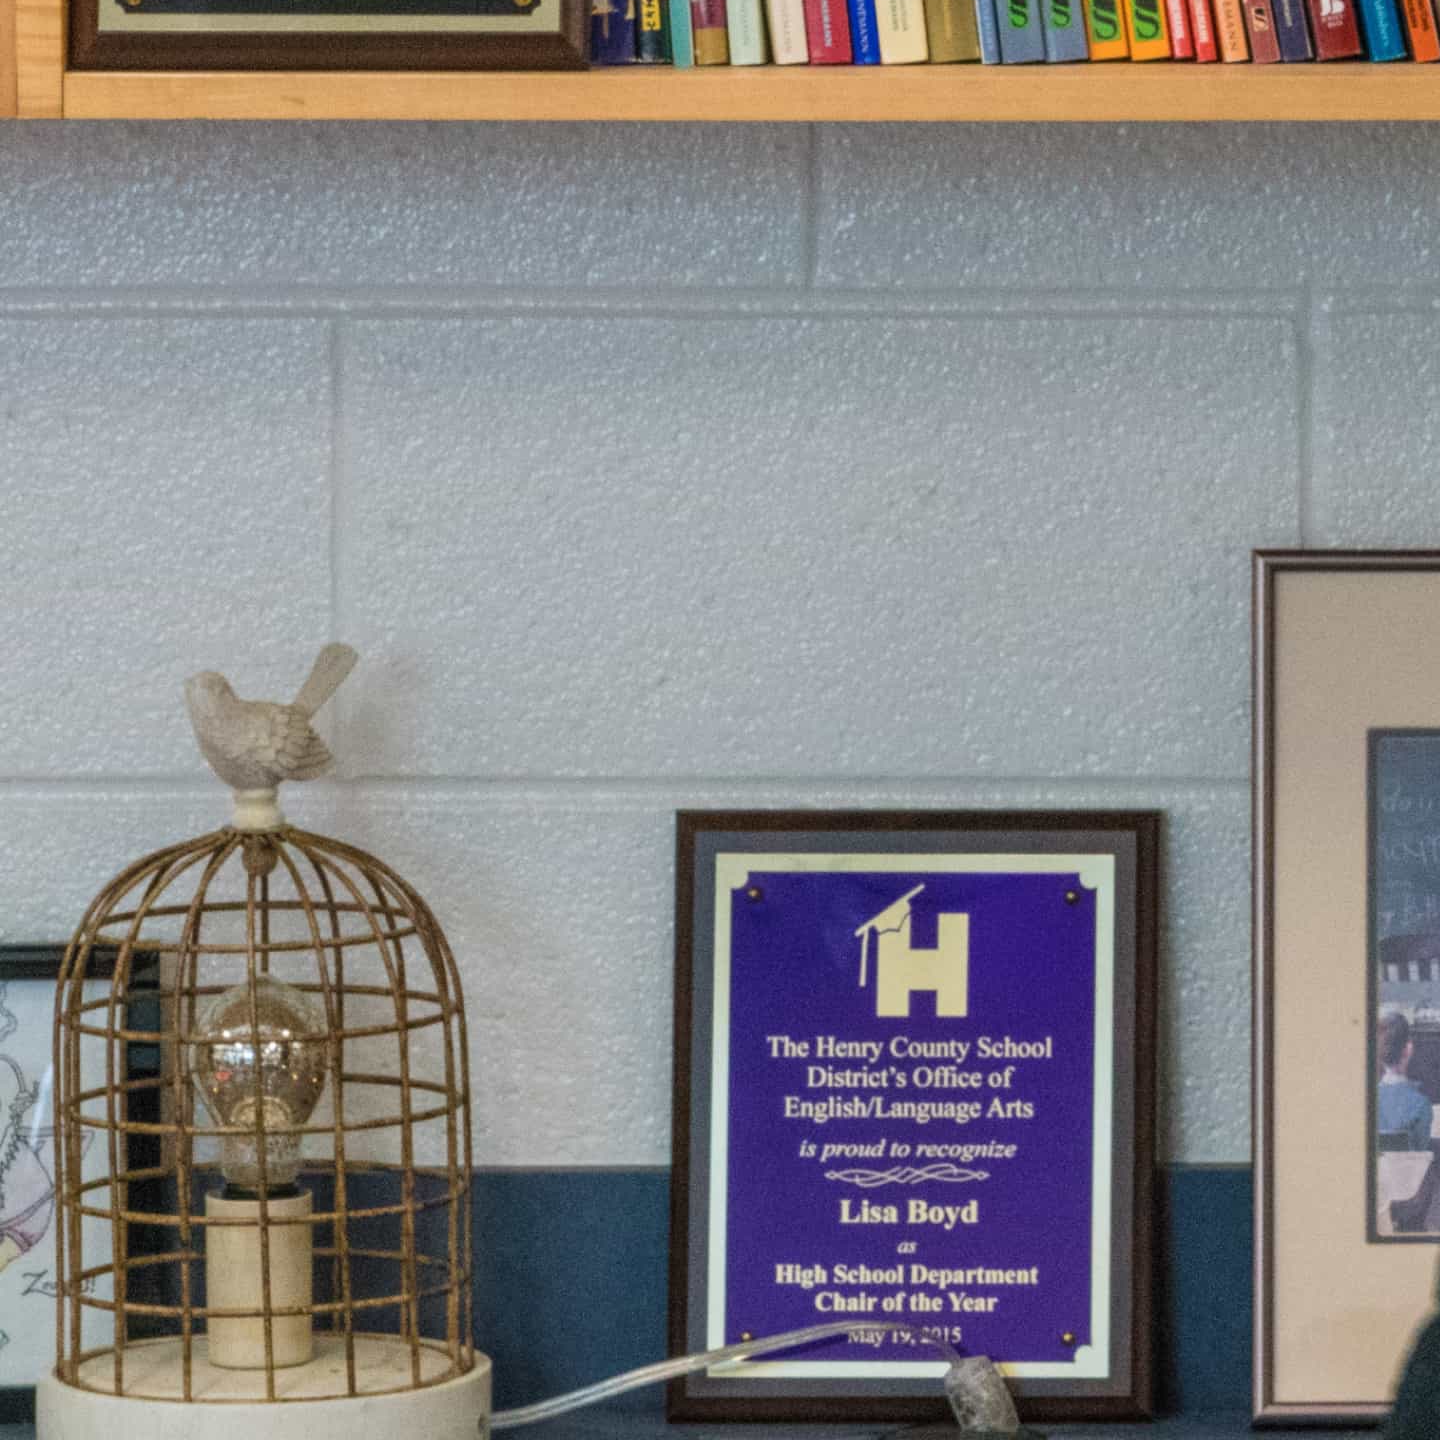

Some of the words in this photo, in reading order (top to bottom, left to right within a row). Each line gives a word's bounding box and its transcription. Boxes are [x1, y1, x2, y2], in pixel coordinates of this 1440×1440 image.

[768, 1037, 809, 1058] The
[816, 1037, 883, 1064] Henry
[890, 1037, 970, 1064] County
[977, 1037, 1052, 1058] School
[807, 1067, 907, 1088] District's
[913, 1067, 982, 1088] Office
[988, 1067, 1015, 1088] of
[784, 1097, 981, 1123] English/Language
[987, 1098, 1034, 1119] Arts
[799, 1141, 816, 1158] is
[821, 1140, 885, 1162] proud
[890, 1141, 911, 1158] to
[916, 1142, 1017, 1163] recognize
[840, 1200, 898, 1224] Lisa
[907, 1200, 978, 1229] Boyd
[898, 1240, 917, 1254] as
[776, 1265, 828, 1288] High
[833, 1265, 904, 1284] School
[910, 1265, 1038, 1288] Department
[815, 1292, 876, 1312] Chair
[882, 1292, 904, 1312] of
[908, 1293, 943, 1312] the
[949, 1293, 998, 1312] Year
[848, 1327, 887, 1345] May
[892, 1326, 915, 1344] 19,
[921, 1326, 961, 1343] 2015
